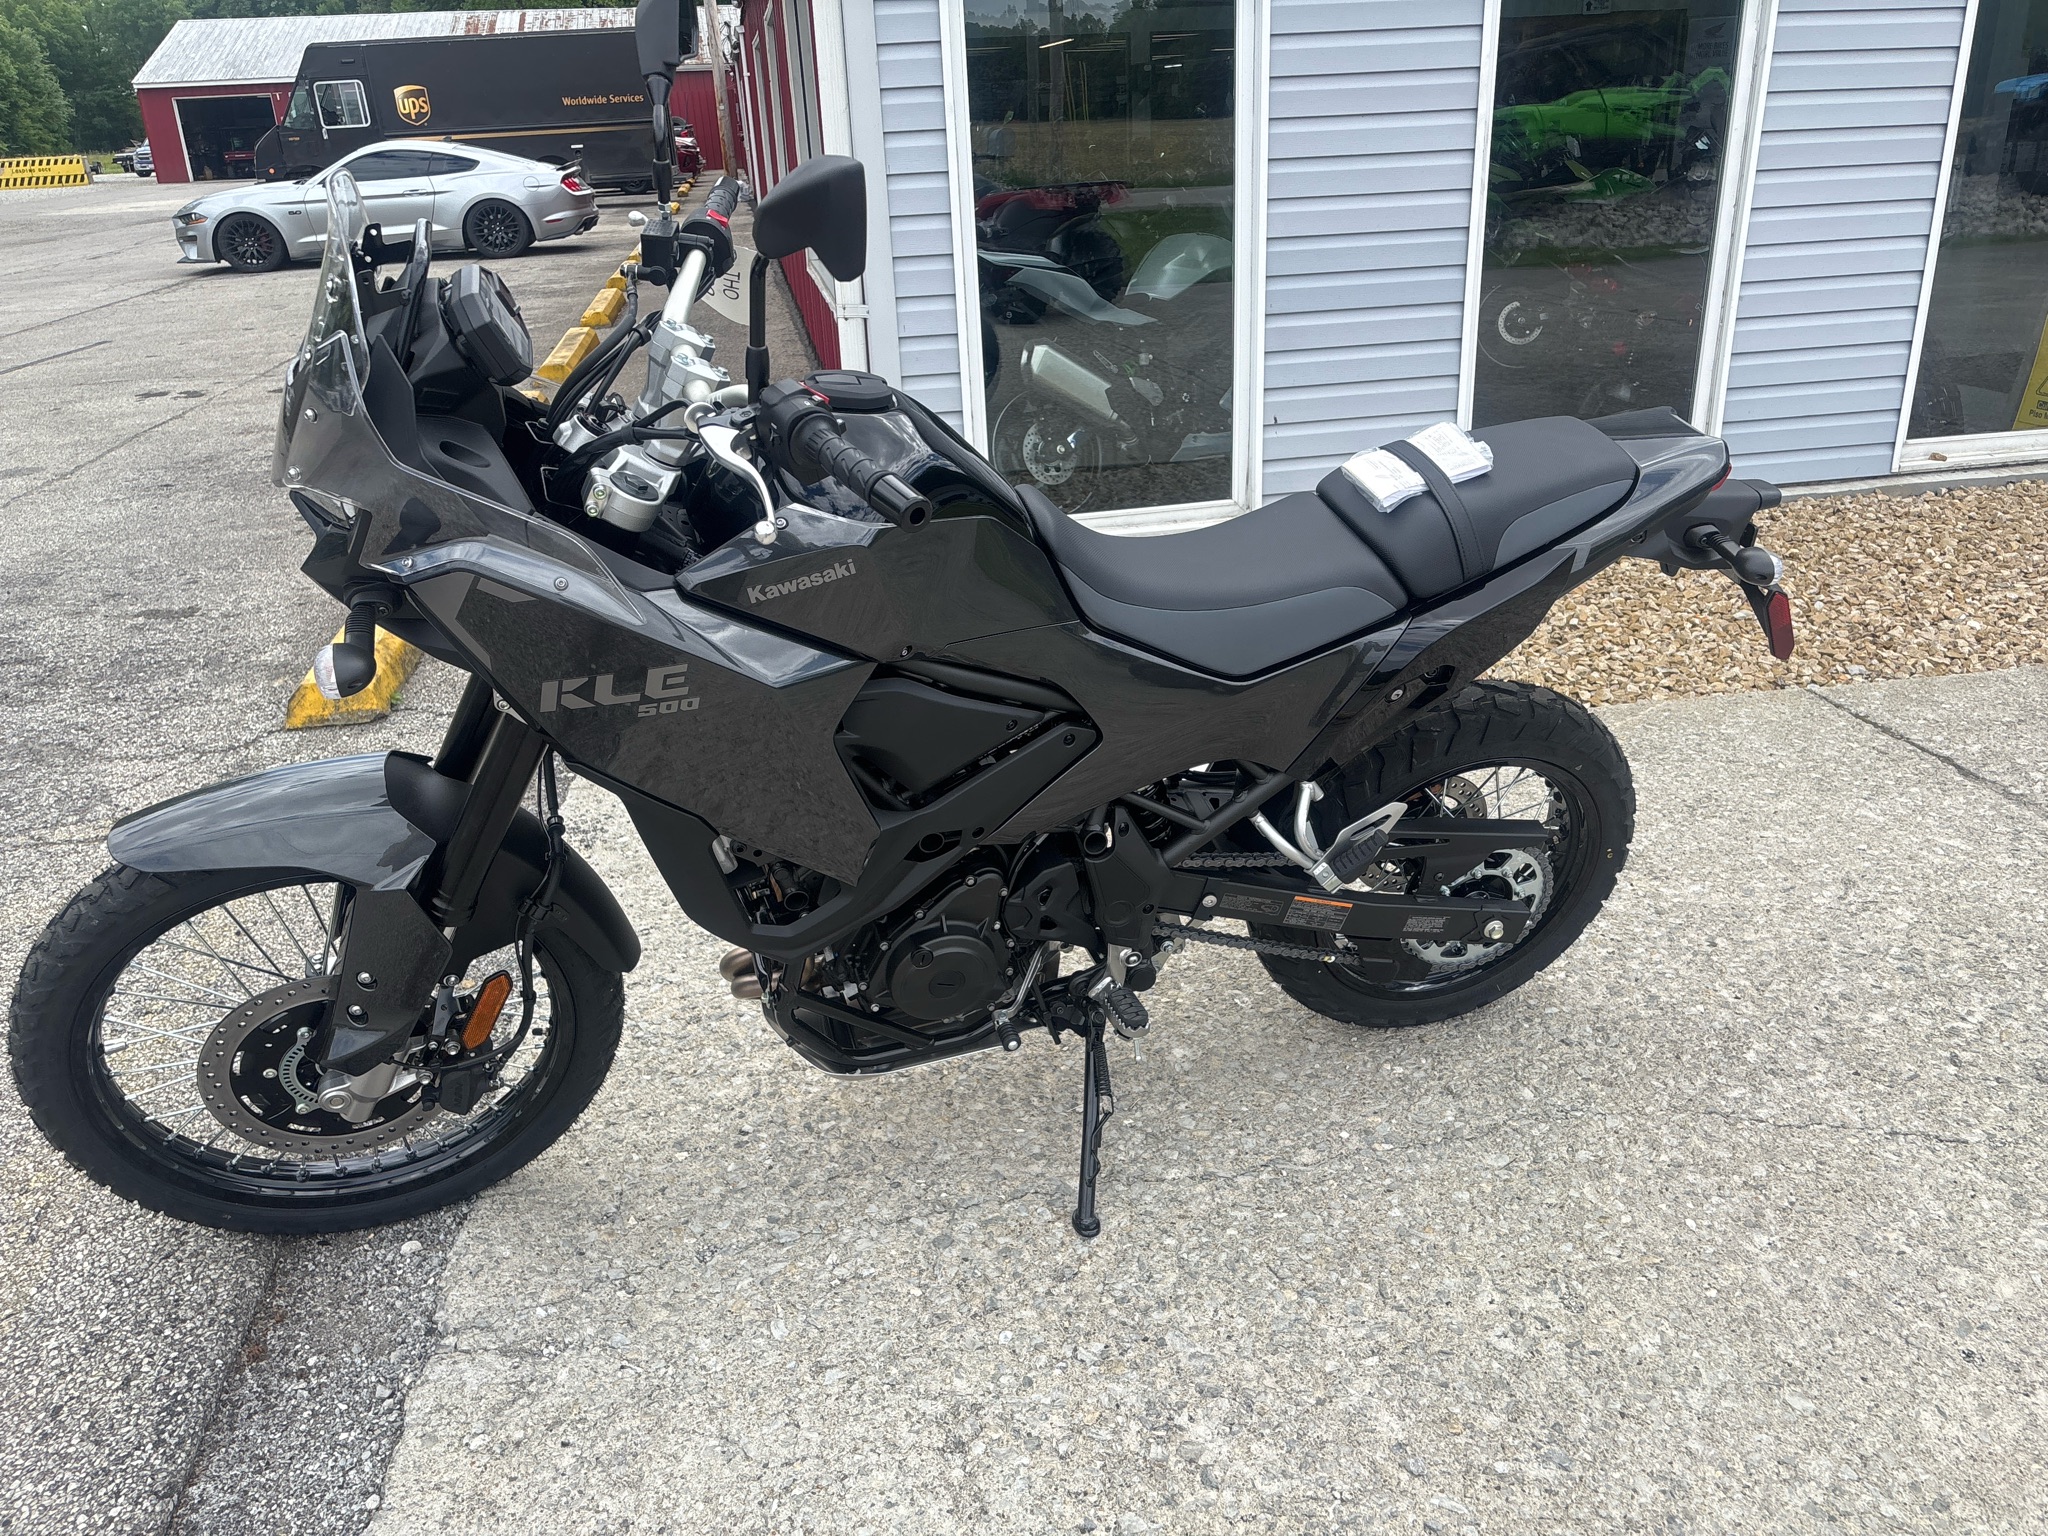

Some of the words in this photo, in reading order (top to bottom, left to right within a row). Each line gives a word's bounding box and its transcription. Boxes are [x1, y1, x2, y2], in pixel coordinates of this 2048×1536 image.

[399, 97, 428, 119] ups
[561, 94, 608, 106] Worldwide
[608, 93, 644, 104] Services
[746, 558, 857, 605] Kawasaki
[539, 663, 690, 713] KLE
[637, 697, 700, 718] 500
